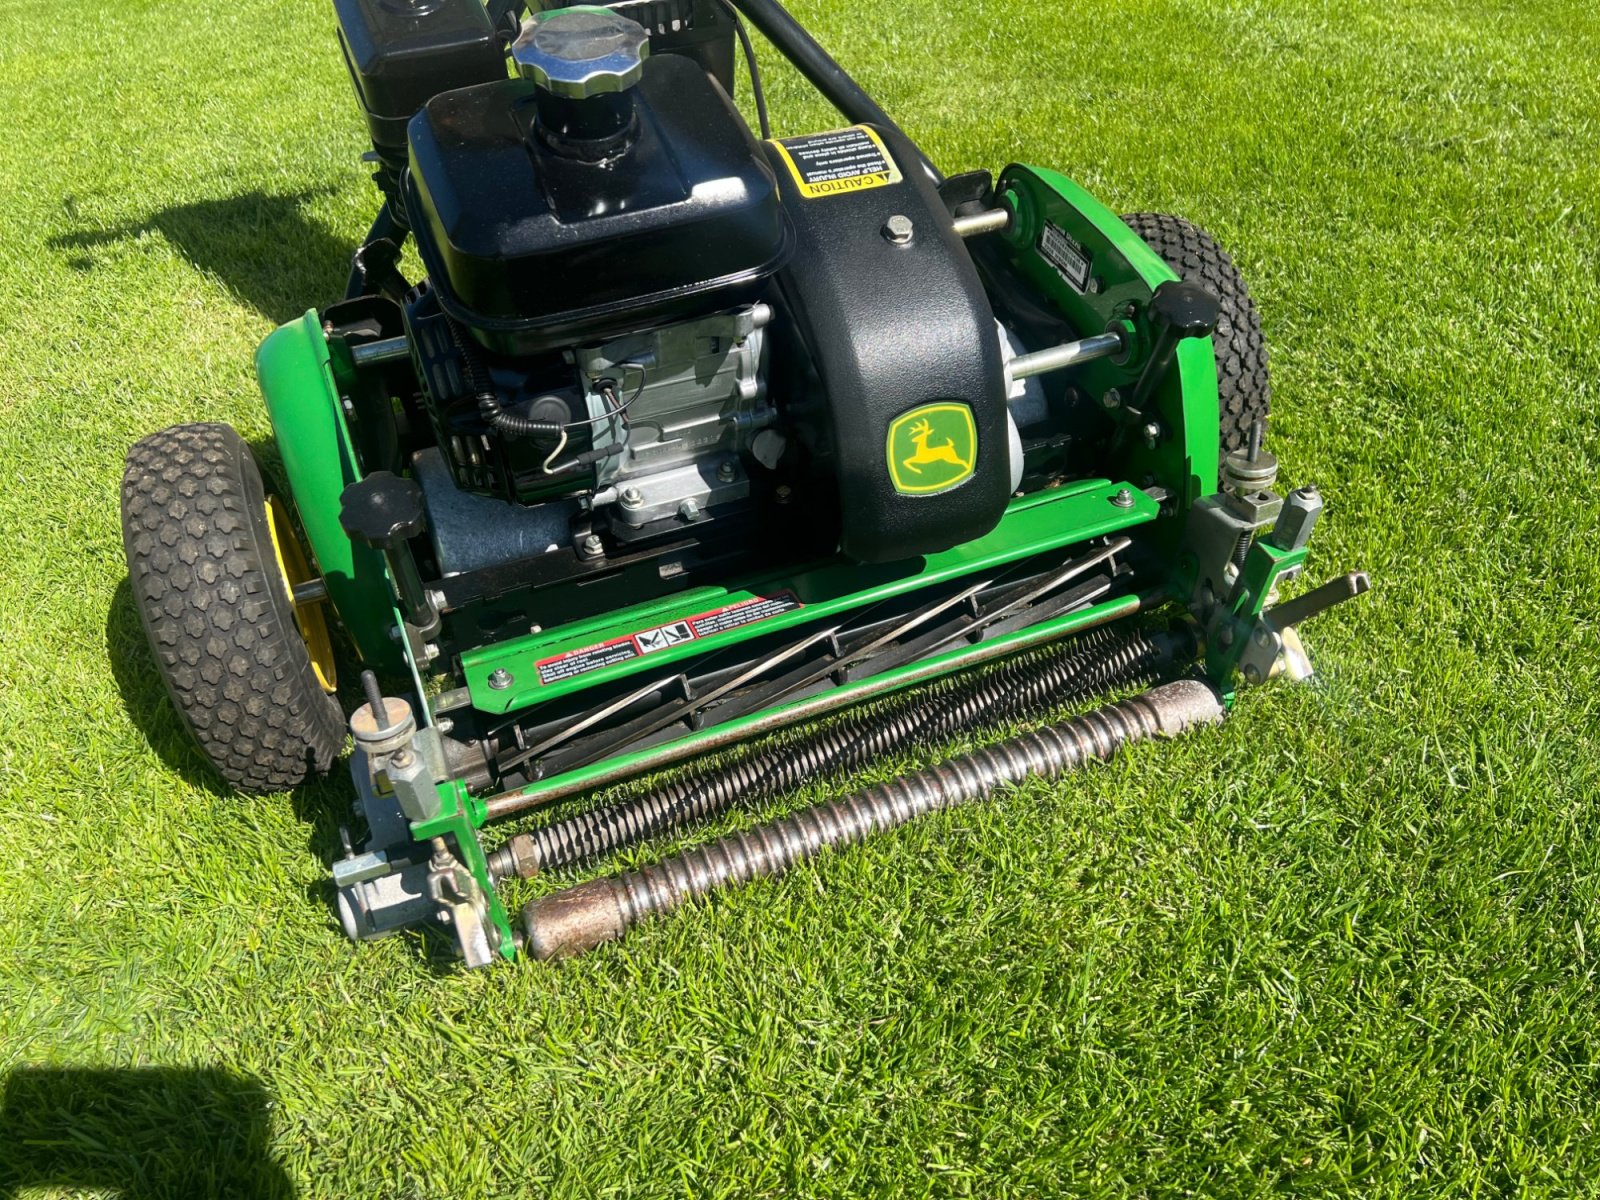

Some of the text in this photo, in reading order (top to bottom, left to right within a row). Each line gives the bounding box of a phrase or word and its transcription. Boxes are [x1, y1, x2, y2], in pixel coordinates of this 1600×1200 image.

[809, 165, 883, 183] HELP AVOID INJURY
[810, 176, 874, 194] CAUTION
[729, 596, 759, 611] PELIGRO
[573, 642, 604, 655] DANGER
